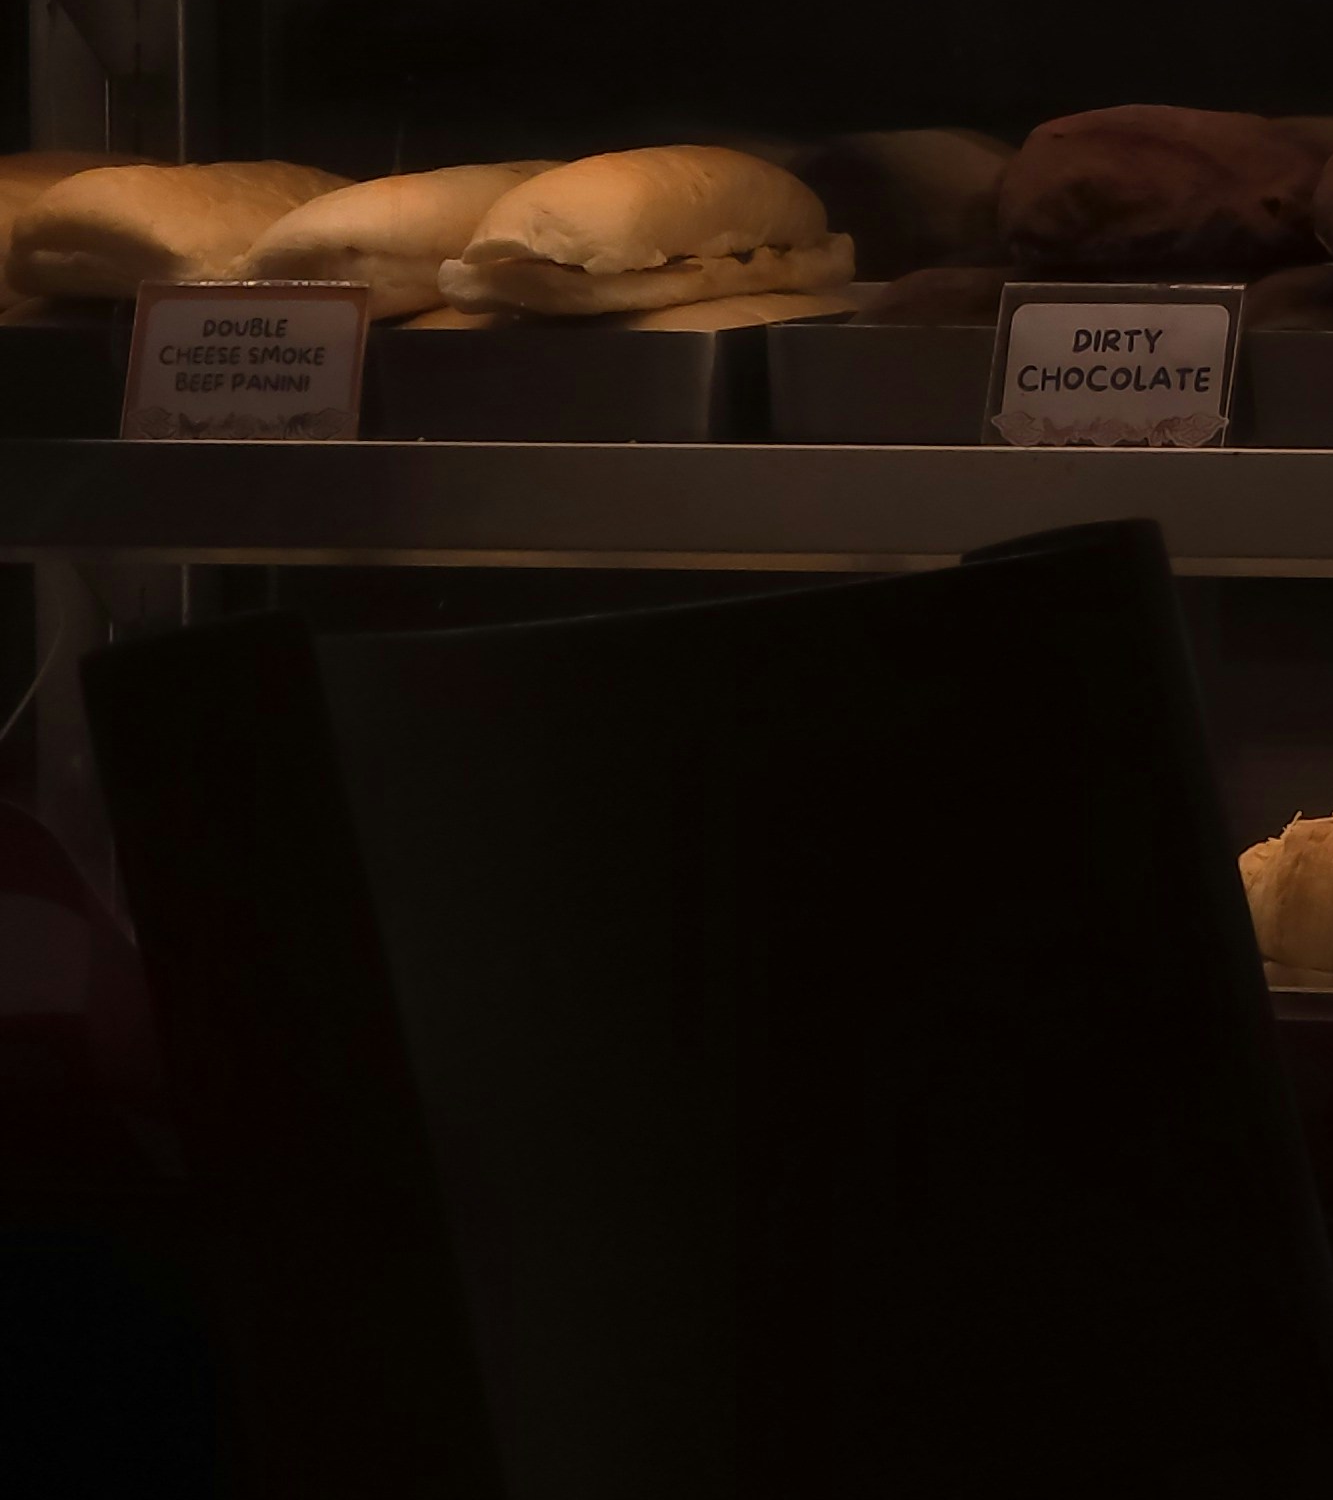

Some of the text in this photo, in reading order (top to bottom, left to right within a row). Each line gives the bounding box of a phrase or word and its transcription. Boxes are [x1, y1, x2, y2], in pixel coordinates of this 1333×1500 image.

[203, 318, 288, 338] DOUBLE
[1073, 328, 1162, 353] DIRTY
[159, 345, 325, 365] CHEESE SMOKE
[175, 372, 310, 392] BEEF PANINI
[1018, 365, 1210, 392] CHOCOLATE
